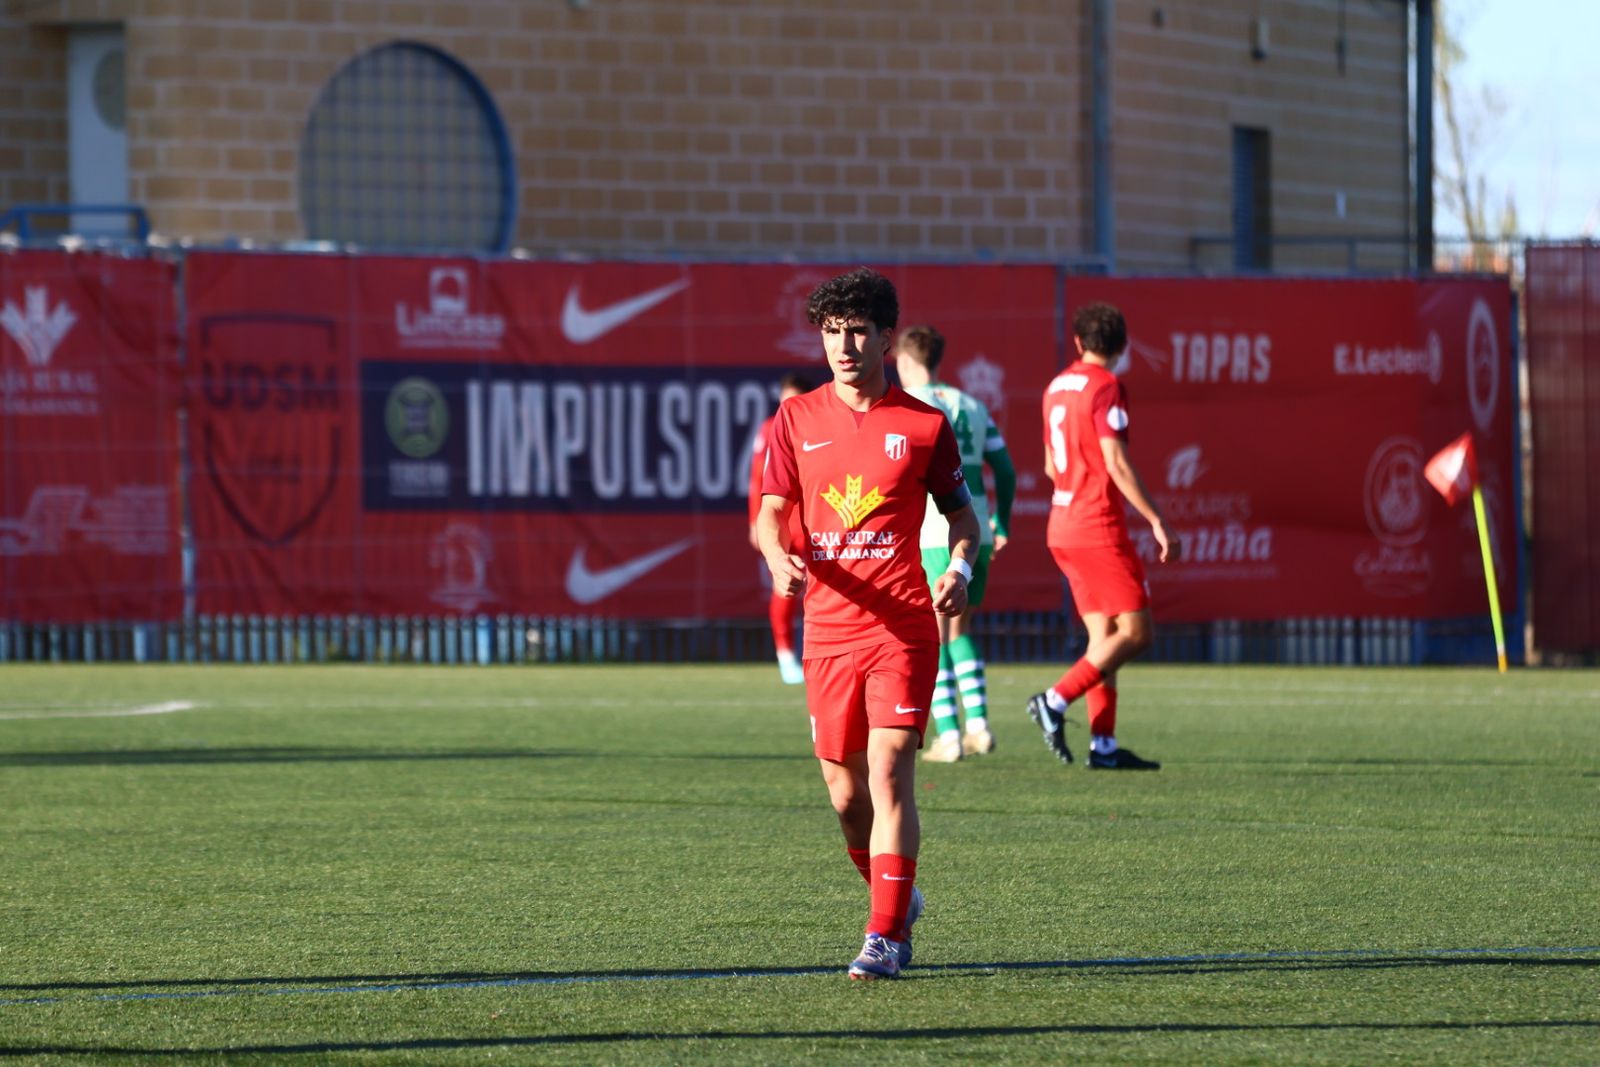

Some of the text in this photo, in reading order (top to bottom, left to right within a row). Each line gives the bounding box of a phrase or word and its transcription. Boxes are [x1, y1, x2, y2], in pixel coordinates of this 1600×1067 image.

[1171, 333, 1272, 384] TAPAS
[202, 362, 339, 412] UDSM
[466, 378, 779, 499] IMPULSO2
[811, 530, 896, 548] CAJA RURAL
